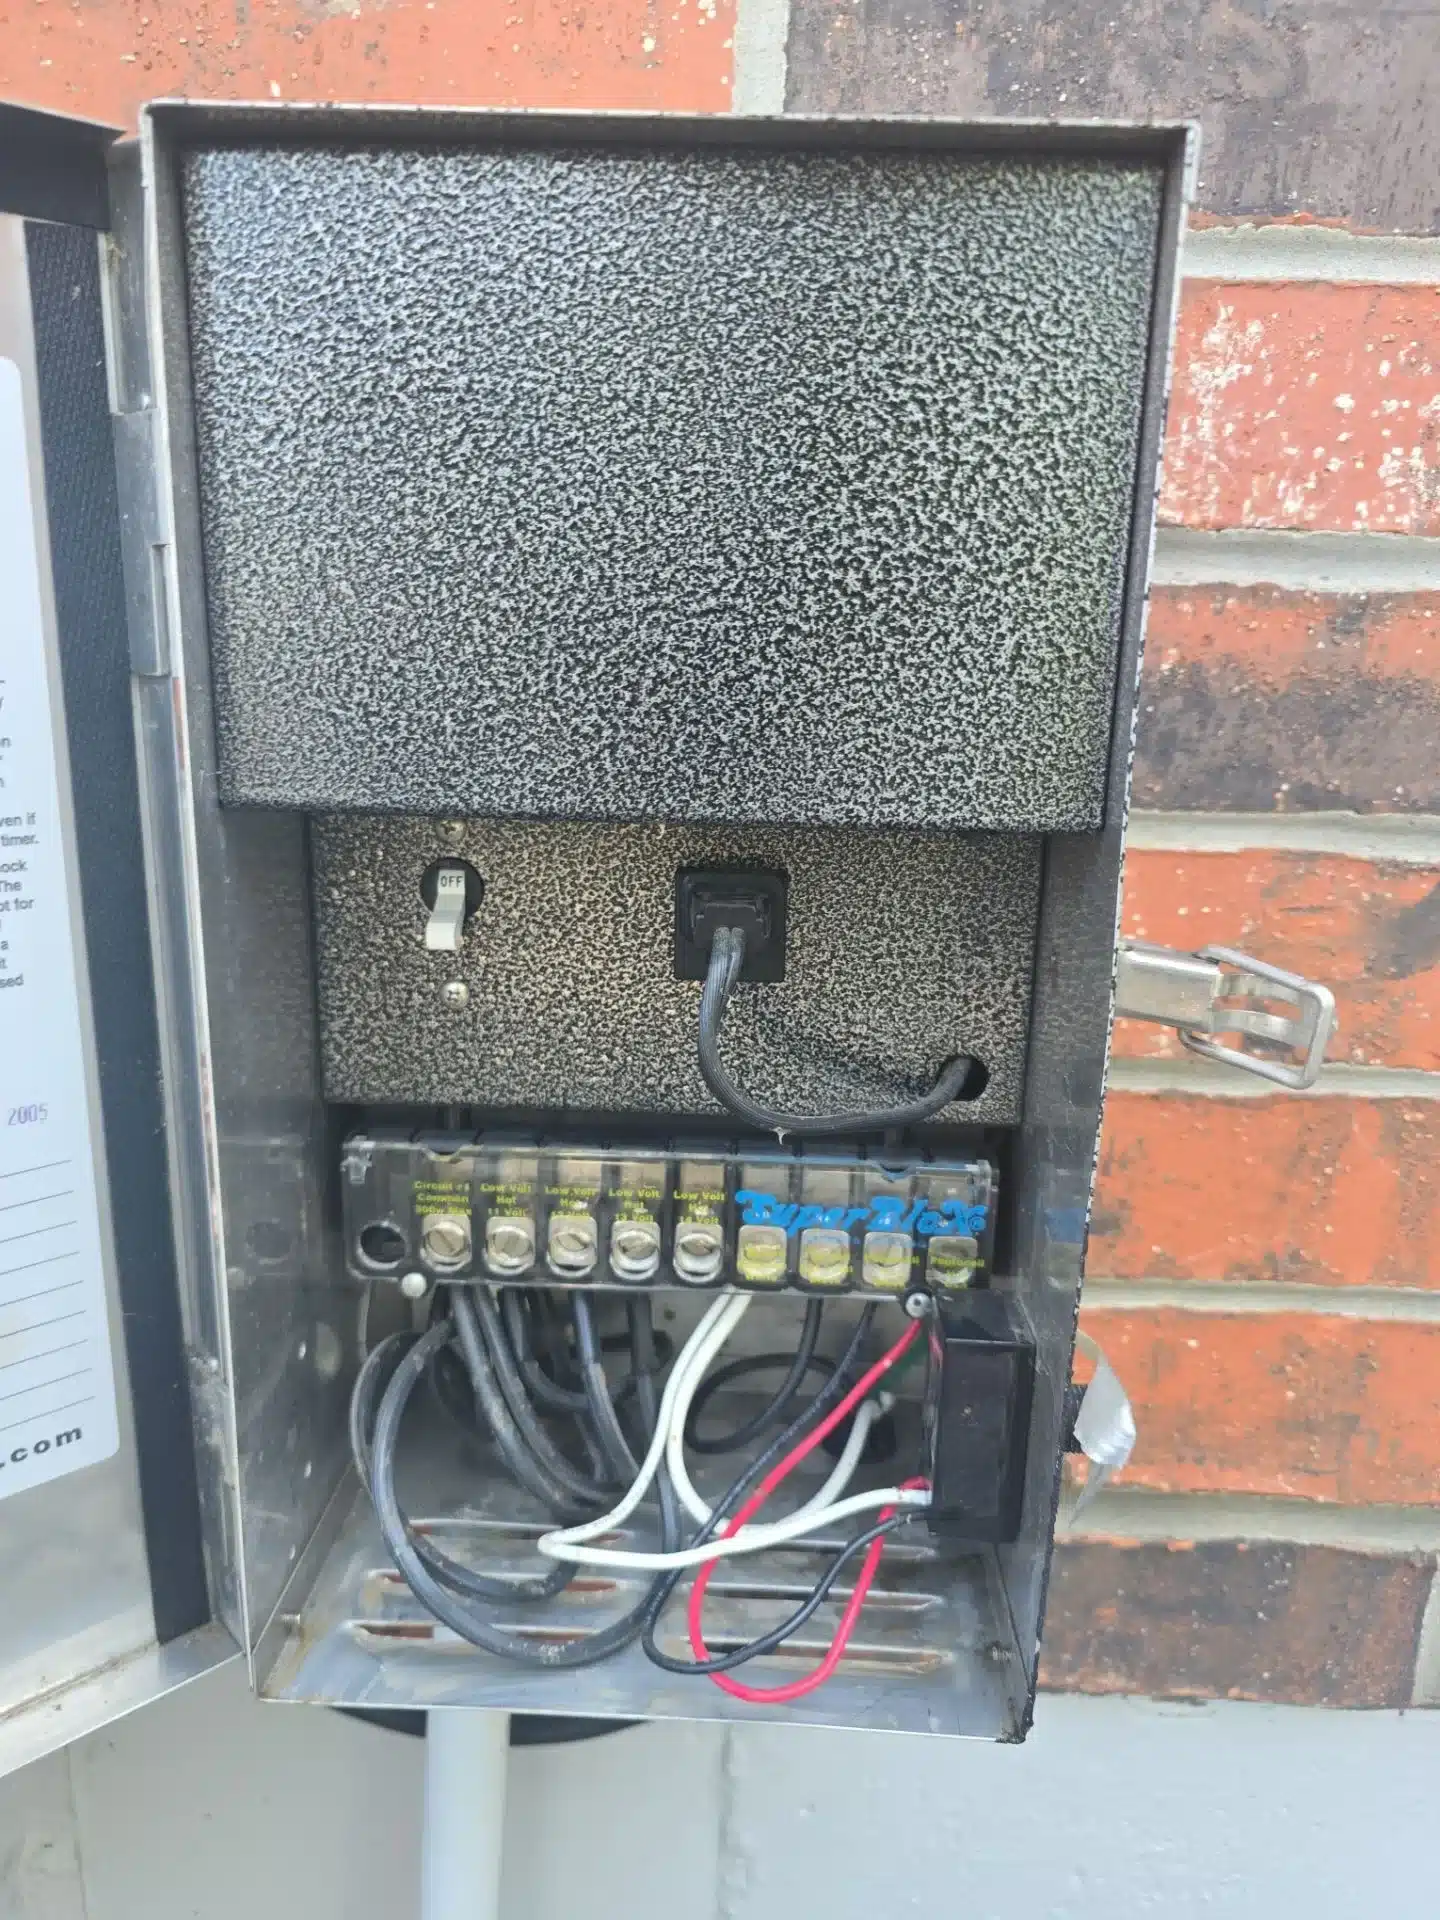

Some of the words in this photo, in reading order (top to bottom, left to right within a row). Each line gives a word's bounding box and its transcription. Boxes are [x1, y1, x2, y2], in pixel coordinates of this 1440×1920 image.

[0, 834, 40, 846] timer.
[440, 876, 463, 888] OFF
[14, 898, 35, 911] for
[8, 1103, 49, 1126] 2005
[609, 1187, 633, 1197] Low
[638, 1189, 661, 1198] Volt
[674, 1190, 698, 1200] Low
[702, 1191, 725, 1201] Volt
